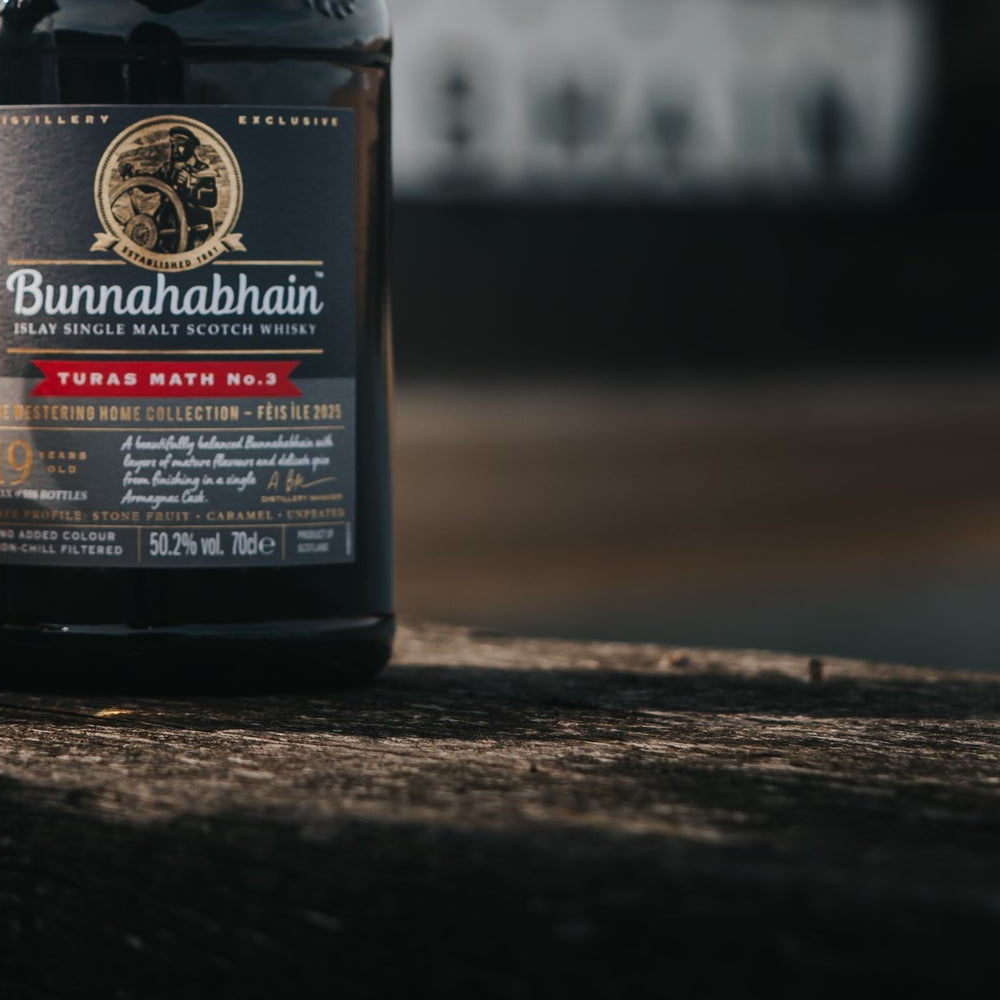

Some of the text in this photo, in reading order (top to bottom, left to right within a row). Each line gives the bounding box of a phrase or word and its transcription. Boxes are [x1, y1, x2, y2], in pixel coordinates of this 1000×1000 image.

[237, 115, 338, 127] EXCLUSIVE
[121, 246, 191, 270] ESTABLISHED
[5, 268, 324, 317] Bunnahabhain
[13, 322, 316, 336] ISLAY SINGLE MALT SCOTCH WHISKY
[57, 372, 277, 386] TURAS MATH No.3
[13, 403, 95, 421] WESTERING
[100, 405, 141, 421] HOME
[146, 405, 240, 421] COLLECTION
[313, 403, 342, 420] 2025
[120, 434, 133, 451] A
[134, 434, 195, 455] beautifully
[197, 434, 244, 450] balanced
[38, 450, 87, 460] YEARS
[47, 465, 77, 474] OLD
[123, 453, 156, 474] layers
[158, 453, 170, 469] of
[171, 455, 211, 468] mature
[212, 453, 254, 470] flavours
[255, 453, 276, 467] and
[122, 471, 150, 487] from
[151, 470, 200, 491] finishing
[202, 473, 214, 485] in
[226, 471, 257, 492] single
[39, 489, 88, 500] BOTTLES
[120, 488, 209, 510] Armagnac Cask.
[23, 509, 86, 521] PROFILE:
[92, 510, 140, 521] STONE
[146, 510, 190, 521] FRUIT
[206, 509, 273, 522] CARAMEL
[18, 530, 58, 540] ADDED
[62, 531, 116, 542] COLOUR
[60, 544, 124, 556] FILTERED
[149, 531, 198, 556] 50.2%
[200, 531, 225, 556] vol.
